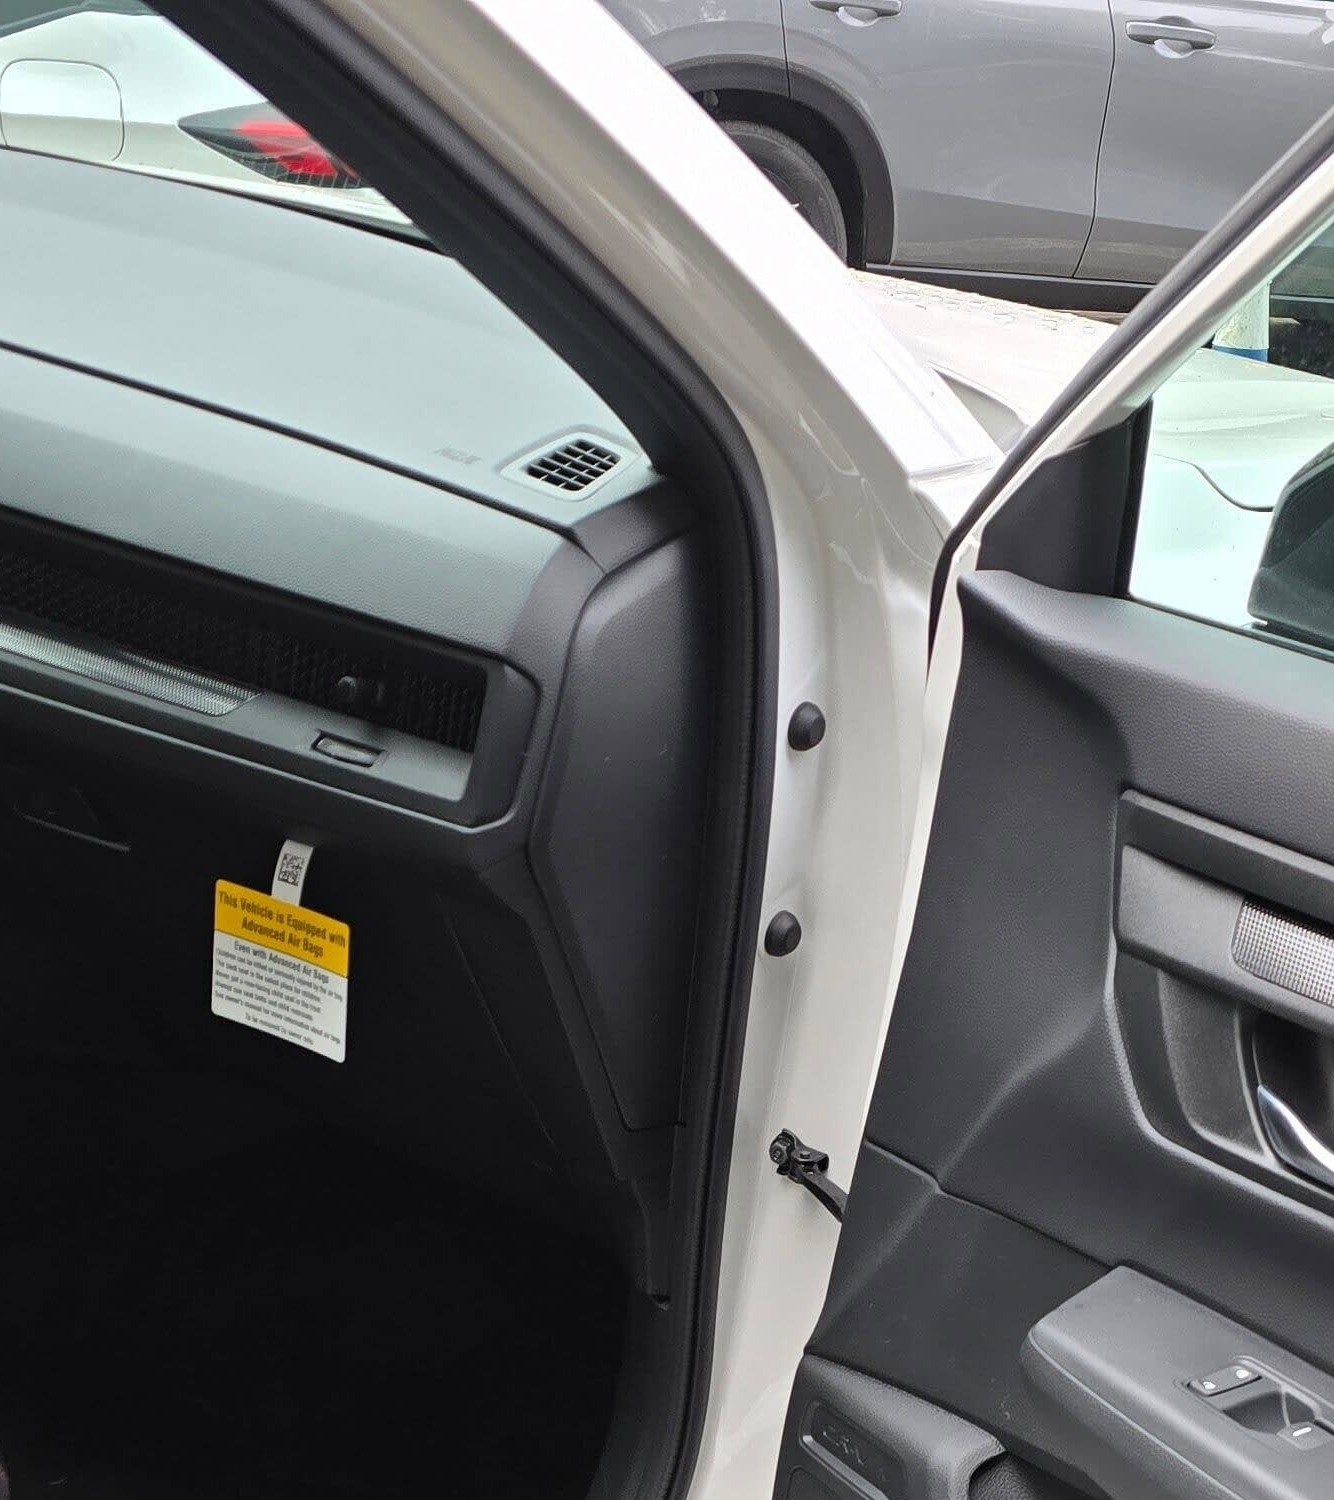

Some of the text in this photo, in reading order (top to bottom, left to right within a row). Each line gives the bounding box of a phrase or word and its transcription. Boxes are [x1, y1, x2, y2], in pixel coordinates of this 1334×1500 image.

[218, 890, 346, 949] This Vehicle is Equipped with
[241, 916, 324, 959] Advanced Air Bags
[234, 940, 251, 955] Even
[268, 951, 301, 973] Advanced
[302, 965, 312, 977] Air
